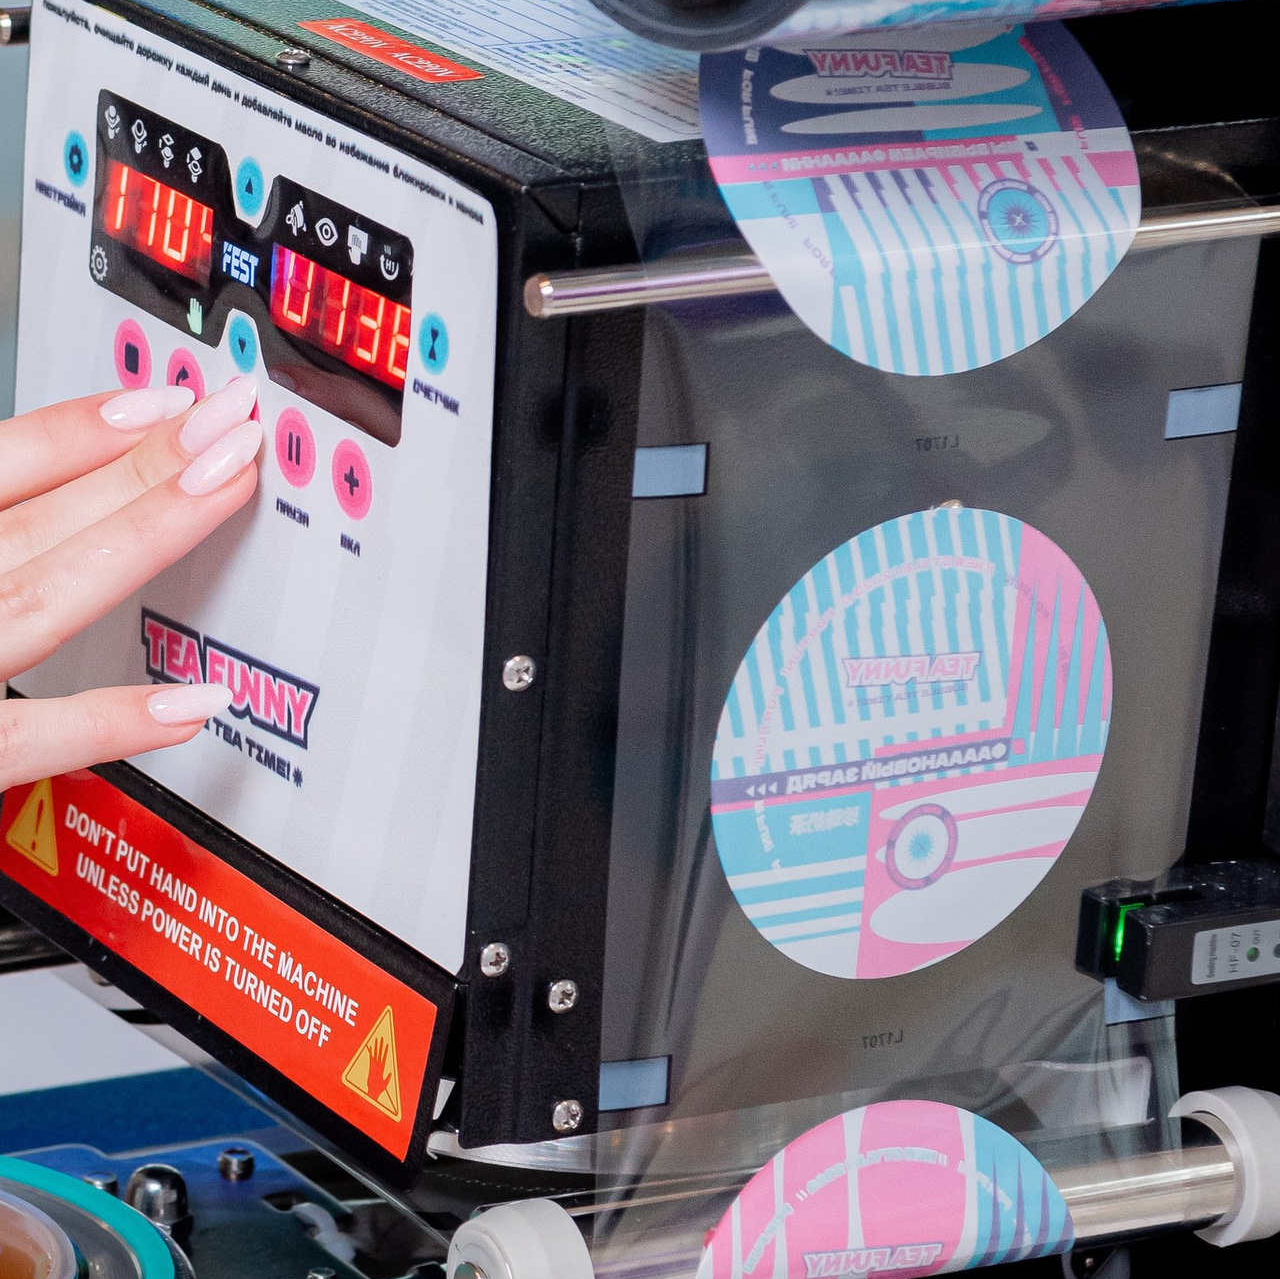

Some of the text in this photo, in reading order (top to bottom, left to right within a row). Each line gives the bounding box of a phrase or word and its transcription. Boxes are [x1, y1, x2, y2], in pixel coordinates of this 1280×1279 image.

[176, 61, 210, 88] каждый
[211, 78, 232, 98] день
[234, 90, 240, 102] и
[241, 93, 292, 128] добавляйте
[326, 131, 337, 149] во
[35, 178, 87, 218] НАСТРОЙКА
[222, 241, 260, 288] FEST
[413, 377, 460, 416] СЧЕТЧИК
[276, 496, 310, 529] ПАУЗА
[340, 531, 361, 558] ВКЛ
[144, 615, 204, 685] TEA
[205, 643, 315, 745] FUNNY
[212, 715, 291, 782] TEA TIME!
[64, 803, 360, 1028] DON'T PUT HAND INTO THE MACHINE
[75, 852, 332, 1048] UNLESS POWER IS TURNED OFF
[1228, 932, 1241, 973] HF-07
